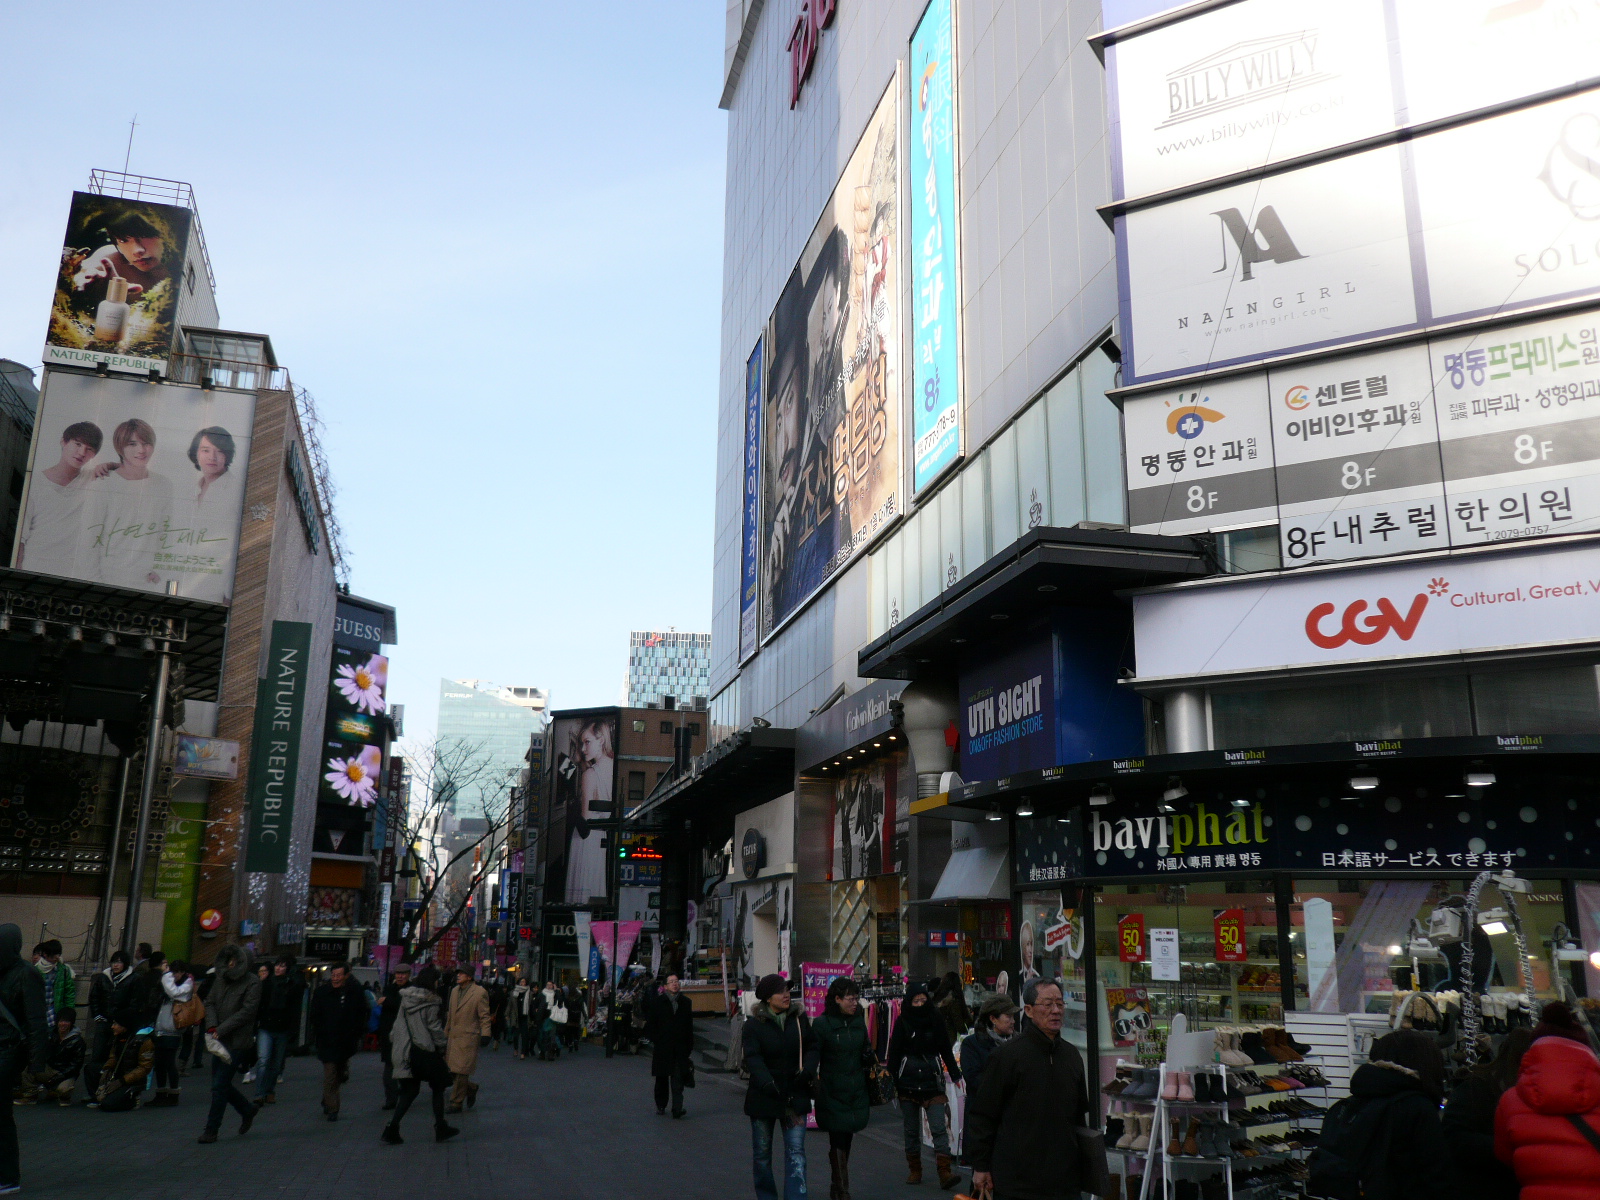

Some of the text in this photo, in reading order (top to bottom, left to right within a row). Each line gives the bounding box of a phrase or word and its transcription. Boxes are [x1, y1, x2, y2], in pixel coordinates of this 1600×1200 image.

[1168, 38, 1319, 116] BILLY WILLY
[50, 348, 161, 371] NATURE REPUBLIC
[1444, 333, 1580, 390] 명동프라미스
[1315, 375, 1390, 407] 센트럴
[1471, 380, 1600, 418] 피부과 성형외과
[833, 353, 887, 505] 명탐정
[1286, 402, 1408, 441] 이비인후과
[1141, 441, 1245, 477] 명동안과
[1515, 434, 1554, 464] 8F
[1341, 462, 1376, 489] 8F
[799, 439, 832, 547] 조선
[1186, 486, 1219, 512] 8F
[1287, 487, 1574, 560] 8F 내추럴 한의원
[1484, 525, 1551, 541] T.2079-0757
[1451, 588, 1526, 608] Cultural,
[1529, 581, 1584, 602] Great,
[334, 616, 382, 642] GUESS
[1305, 593, 1430, 650] CGV
[846, 705, 867, 733] Calvin
[867, 694, 885, 722] Klein
[968, 675, 1042, 737] UTH 8IGHT
[993, 722, 1020, 746] FASHION
[1022, 714, 1044, 736] STORE
[1496, 735, 1544, 746] baviphat
[260, 648, 298, 844] NATURE REPUBLIC
[1224, 749, 1267, 761] baviphat
[1355, 740, 1402, 752] baviphat
[1113, 759, 1145, 770] baviphat
[1092, 801, 1270, 853] baviphat
[1157, 857, 1188, 871] 外國人
[1190, 855, 1212, 869] 專用
[1239, 852, 1262, 867] 명동
[1322, 851, 1516, 868] 日本語サービス できます
[1123, 929, 1140, 946] 50
[1219, 926, 1239, 945] 50
